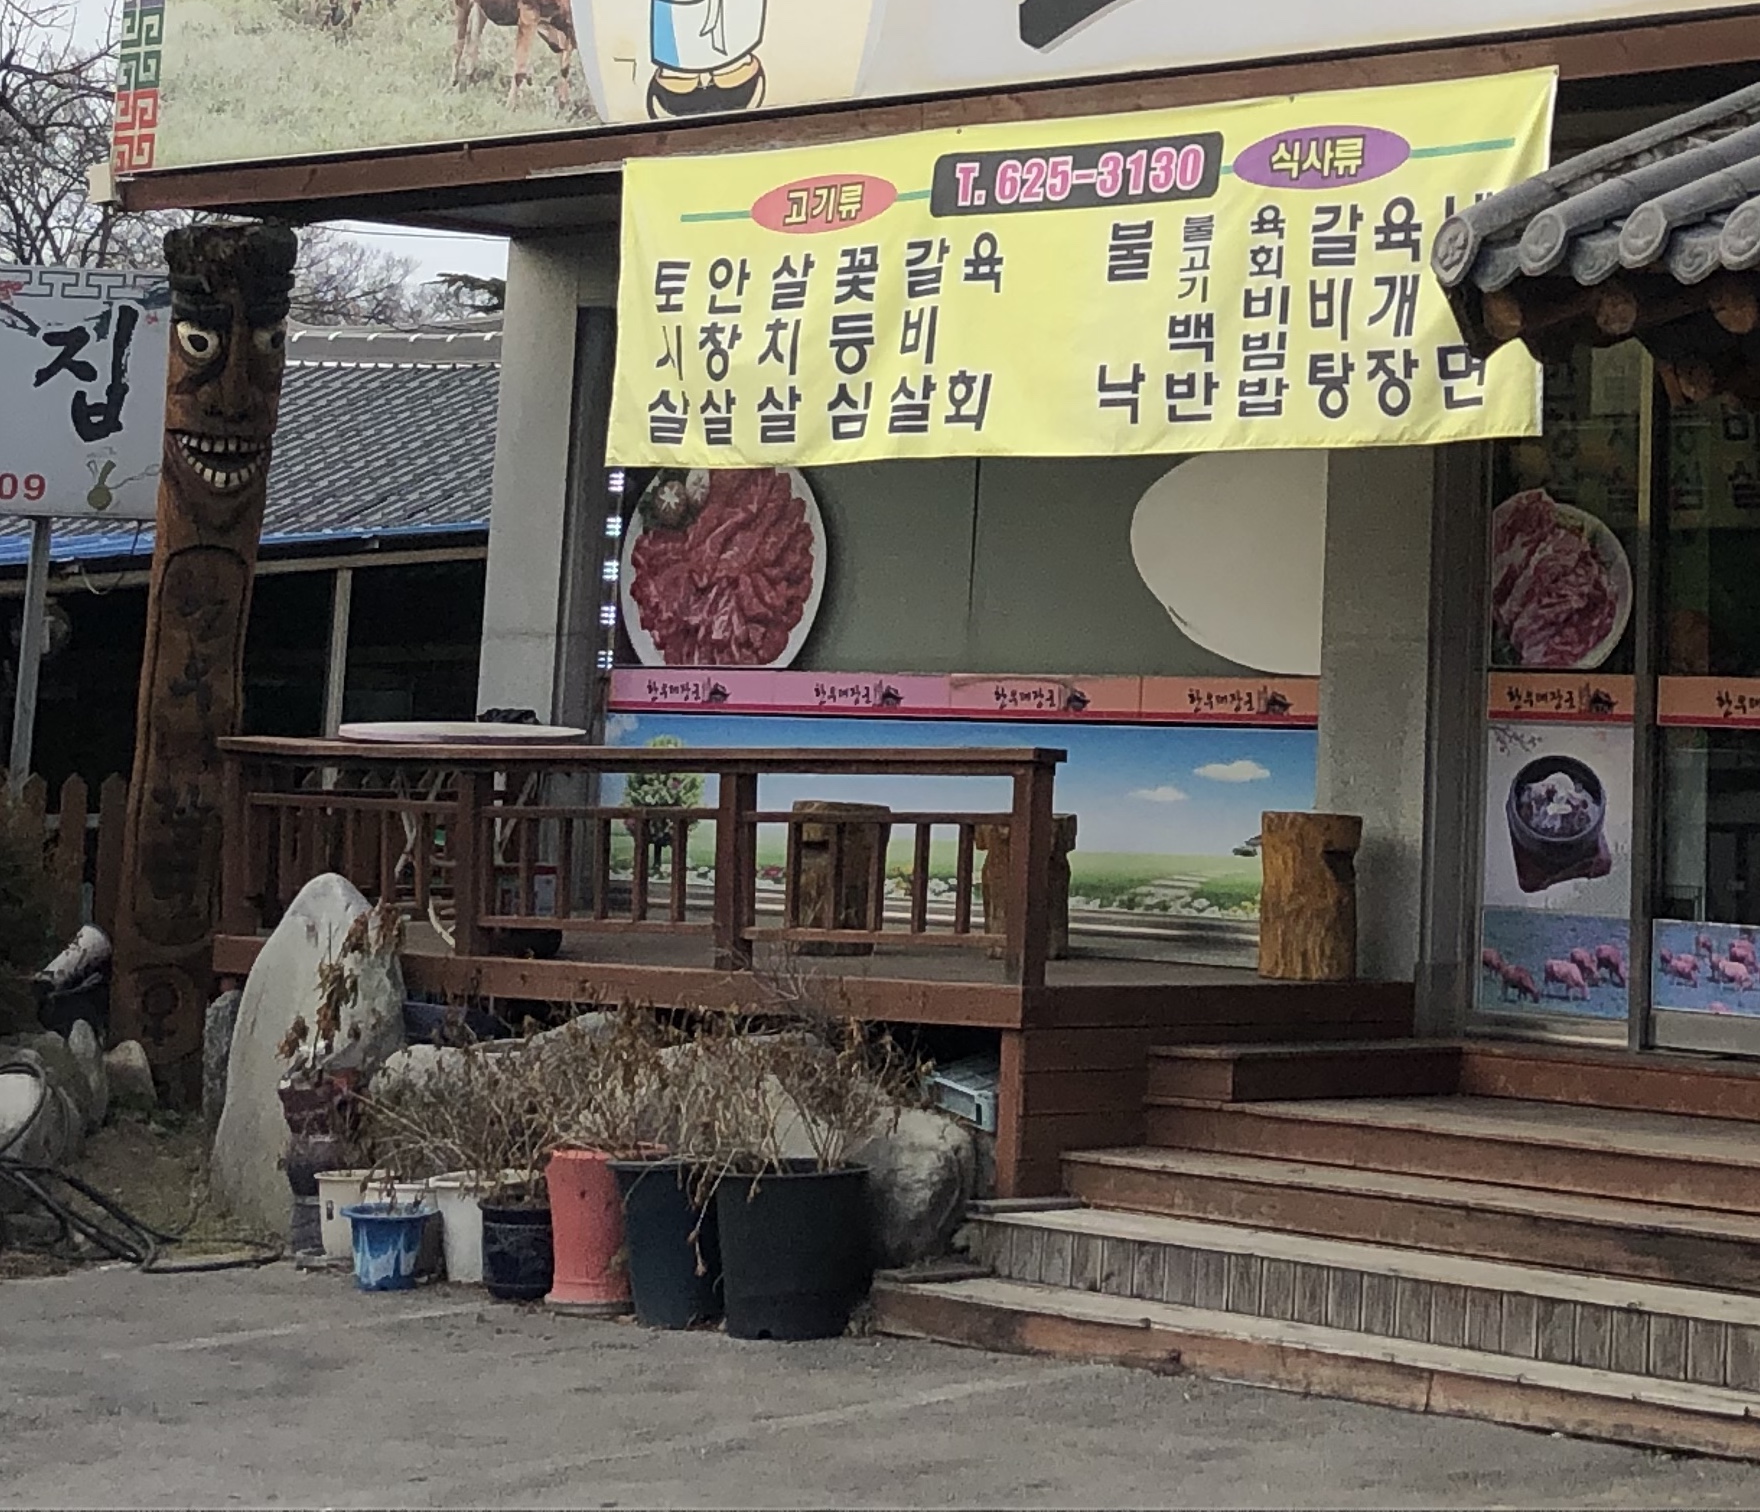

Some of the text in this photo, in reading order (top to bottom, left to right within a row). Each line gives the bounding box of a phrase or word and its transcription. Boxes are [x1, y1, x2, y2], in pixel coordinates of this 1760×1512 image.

[1271, 135, 1367, 181] 식사류
[783, 181, 866, 228] 고기류
[33, 304, 140, 443] 집
